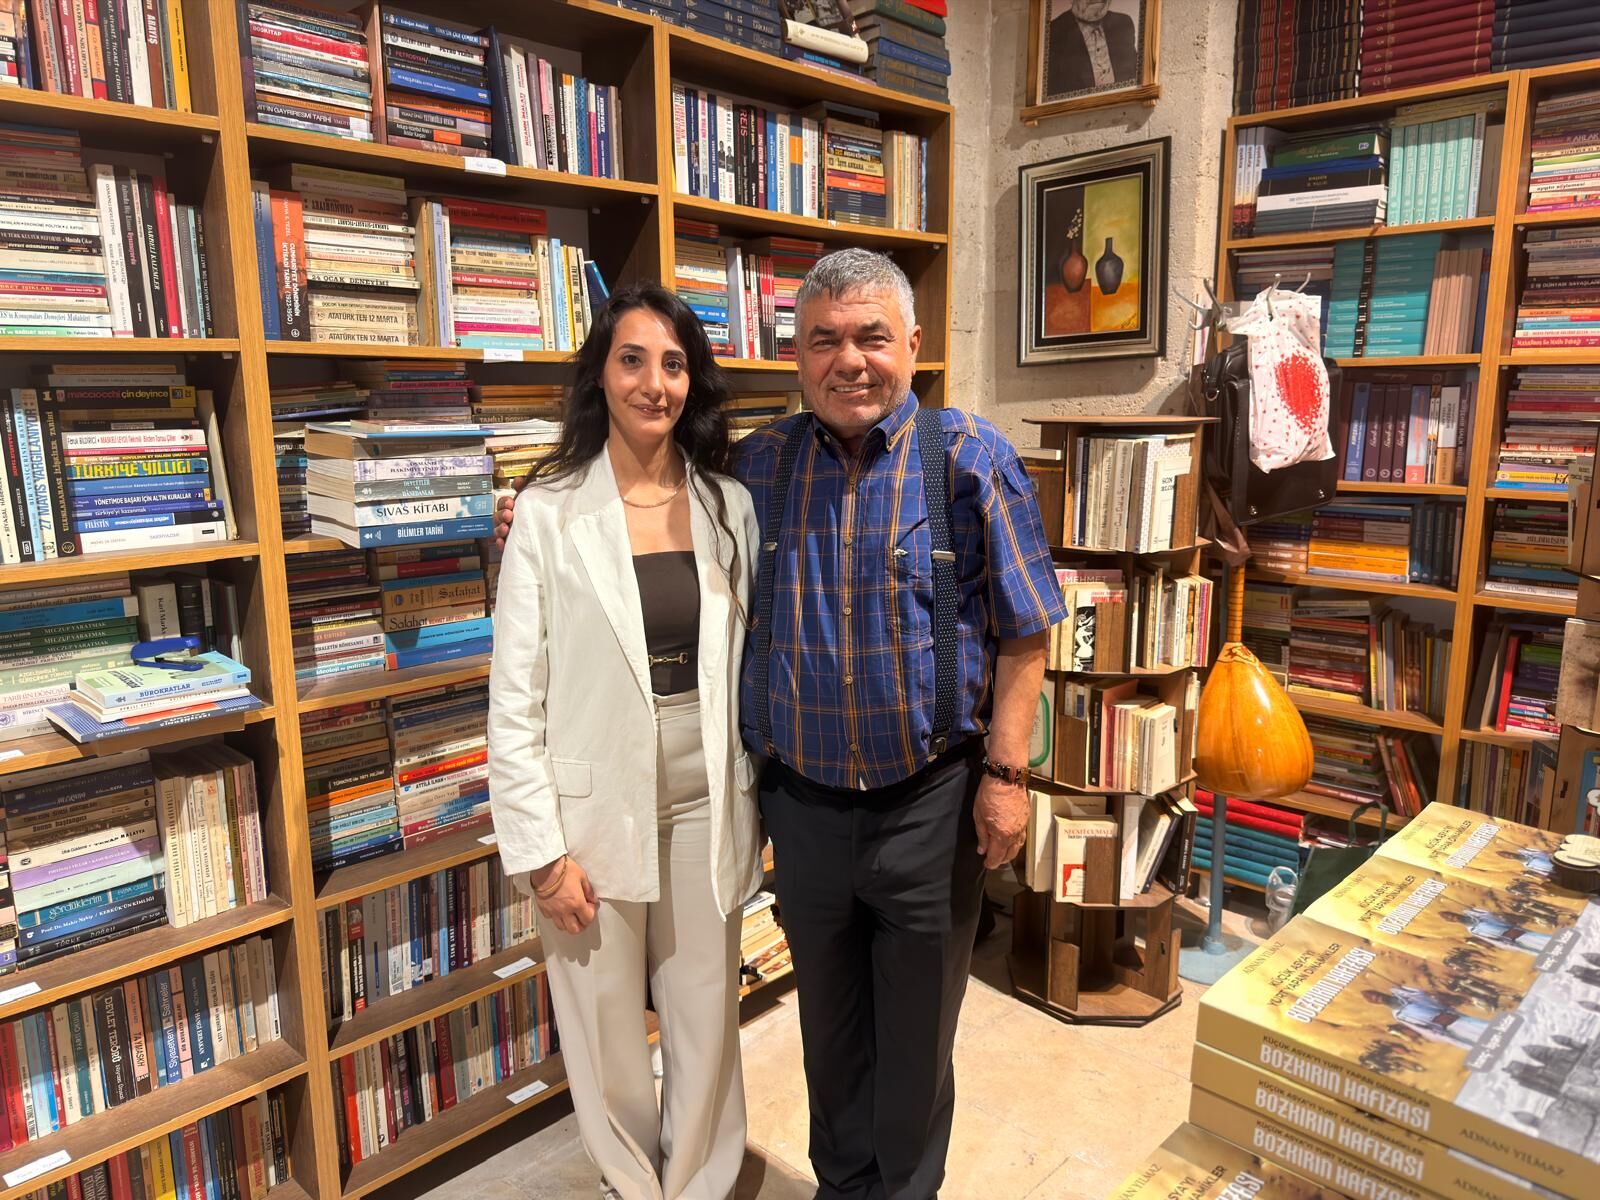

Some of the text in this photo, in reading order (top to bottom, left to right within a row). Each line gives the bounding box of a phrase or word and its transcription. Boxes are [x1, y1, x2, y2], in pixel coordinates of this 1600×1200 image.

[147, 14, 158, 45] ARAYIŞ
[146, 224, 160, 290] DARBELİ KALEMLER
[282, 242, 290, 268] İKTİSADİ
[290, 243, 298, 282] CUMHURİYET
[283, 268, 291, 289] TARİHİ
[350, 277, 390, 286] DENEYİMİ
[369, 314, 376, 322] 12
[369, 334, 376, 342] 12
[121, 390, 135, 399] çin
[136, 390, 169, 400] deyince
[25, 409, 51, 530] 27 MAYIS YARGILANIYOR
[74, 459, 191, 479] TÜRKİYE YILLIĞI
[57, 478, 69, 531] ULUSLARARASI
[94, 498, 123, 506] YÖNETİMDE
[124, 496, 141, 505] BAŞARI
[142, 496, 152, 504] İÇİN
[168, 493, 191, 501] KURALLAR
[95, 507, 147, 517] türkiye'yi kazanmak
[414, 502, 449, 514] KİTABI
[85, 521, 110, 529] FİLİSTİN
[398, 524, 444, 538] BİLİMLER TARİHİ
[439, 586, 480, 599] Safahat
[71, 622, 106, 631] YARATMAK
[71, 631, 106, 640] YARATMAK
[74, 640, 108, 649] YARATMAK
[316, 662, 370, 675] ideoloji politika
[140, 684, 191, 698] BÜROKRATLAR
[49, 896, 103, 919] gördüklerim
[63, 920, 77, 929] Mahir
[1242, 941, 1285, 975] ADNAN YILMAZ
[1270, 950, 1315, 987] KÜÇÜK ASYA'YI
[1267, 942, 1341, 1006] YURT YAPAN DİNAMİKLER
[1286, 946, 1377, 1024] BOZKIRIN HAFIZASI
[104, 997, 116, 1029] DEVLET
[160, 982, 178, 1068] Siyasetten Sahneler
[109, 1031, 121, 1063] TERÖRÜ
[194, 1012, 205, 1055] HANGİ ERBAKAN
[133, 1032, 144, 1067] TAYMASKH
[1263, 1034, 1430, 1108] KÜÇÜK ASYA'YI YURT YAPAN DİNAMİKLER
[1260, 1044, 1431, 1131] BOZKIRIN HAFIZASI
[1258, 1079, 1285, 1096] KÜÇÜK
[1318, 1103, 1339, 1118] YURT
[1340, 1114, 1368, 1130] YAPAN
[1370, 1126, 1424, 1156] DİNAMİKLER
[1255, 1088, 1424, 1181] BOZKIRIN HAFIZASI
[1256, 1120, 1283, 1136] KÜÇÜK
[1316, 1144, 1335, 1160] YURT
[1337, 1155, 1365, 1173] YAPAN
[1253, 1128, 1332, 1180] BOZKIRIN
[1461, 1128, 1565, 1176] ADNAN YILMAZ
[1133, 1163, 1162, 1189] YILMAZ
